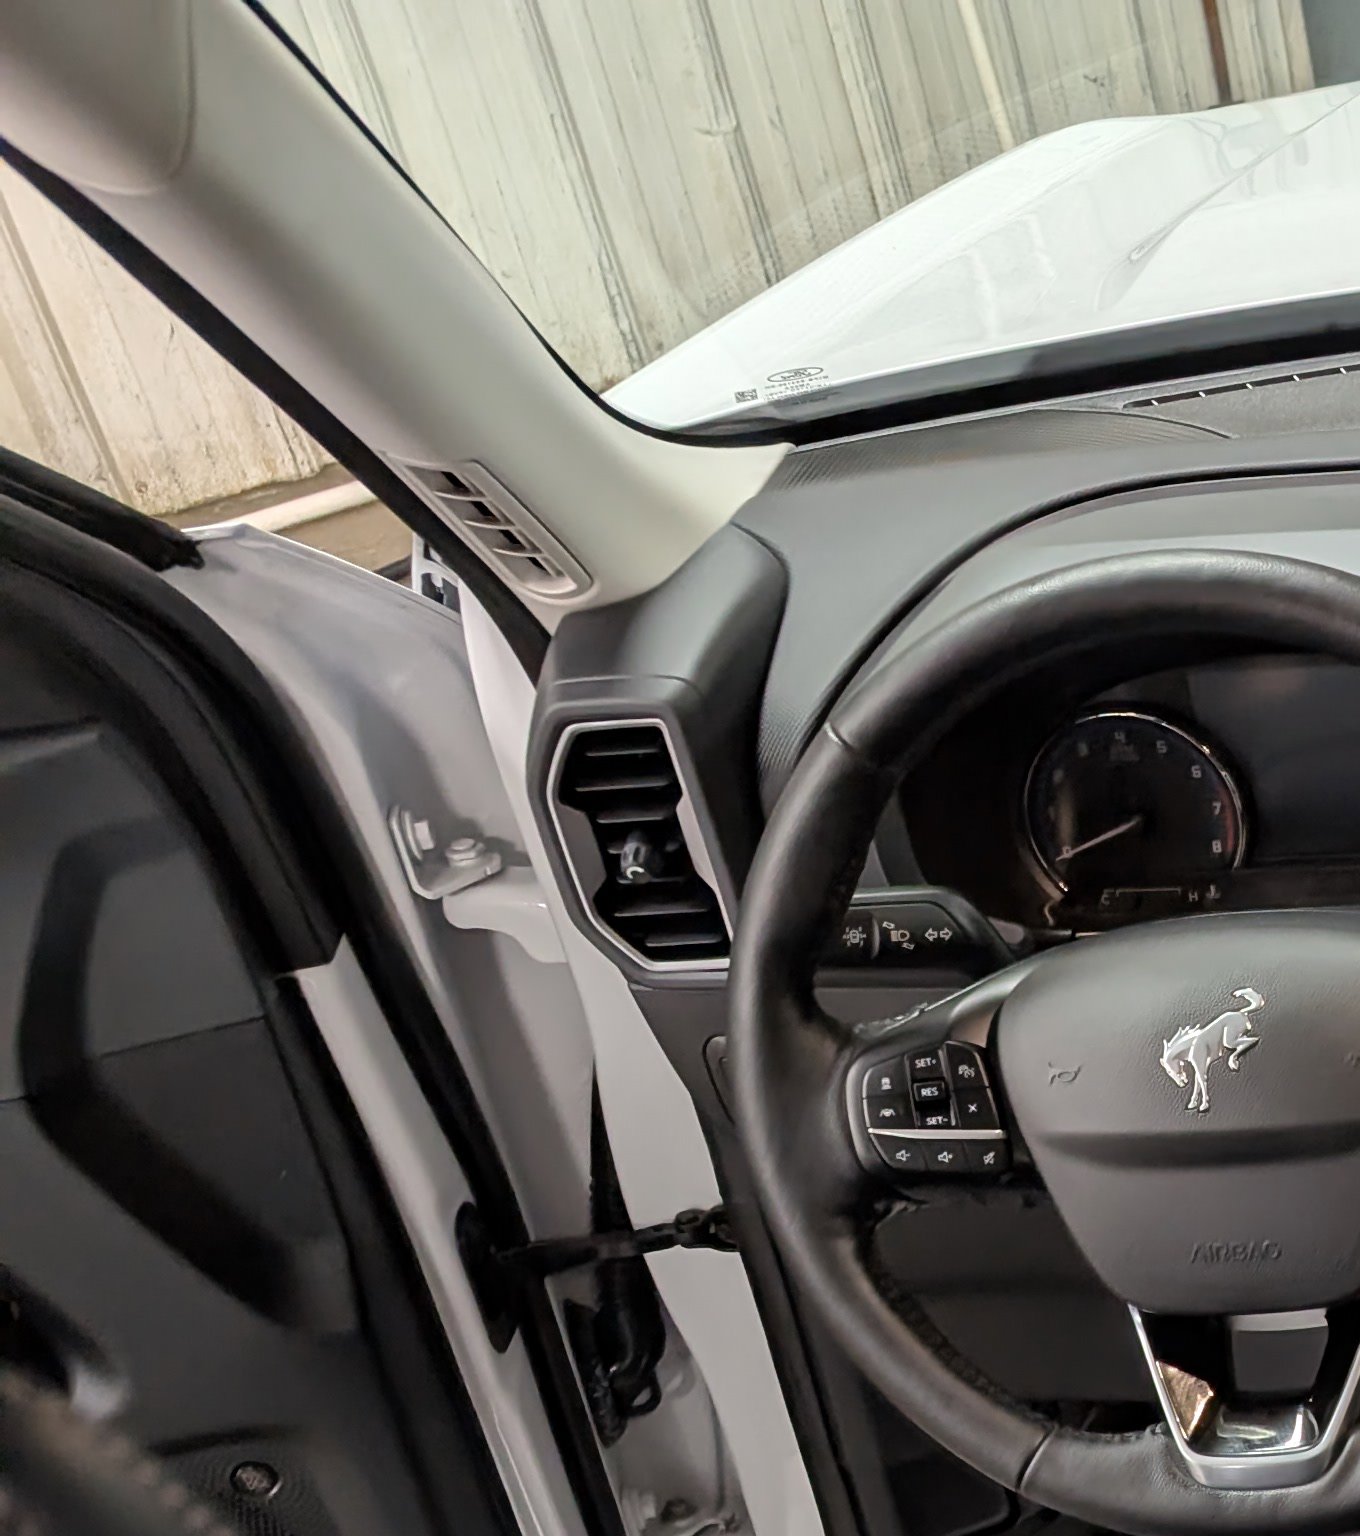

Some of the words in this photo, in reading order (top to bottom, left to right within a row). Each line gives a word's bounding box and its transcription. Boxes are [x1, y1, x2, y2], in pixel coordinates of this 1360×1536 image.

[1114, 731, 1126, 743] 4
[1156, 740, 1167, 753] 5
[1212, 801, 1222, 815] 7
[921, 1087, 939, 1097] RES
